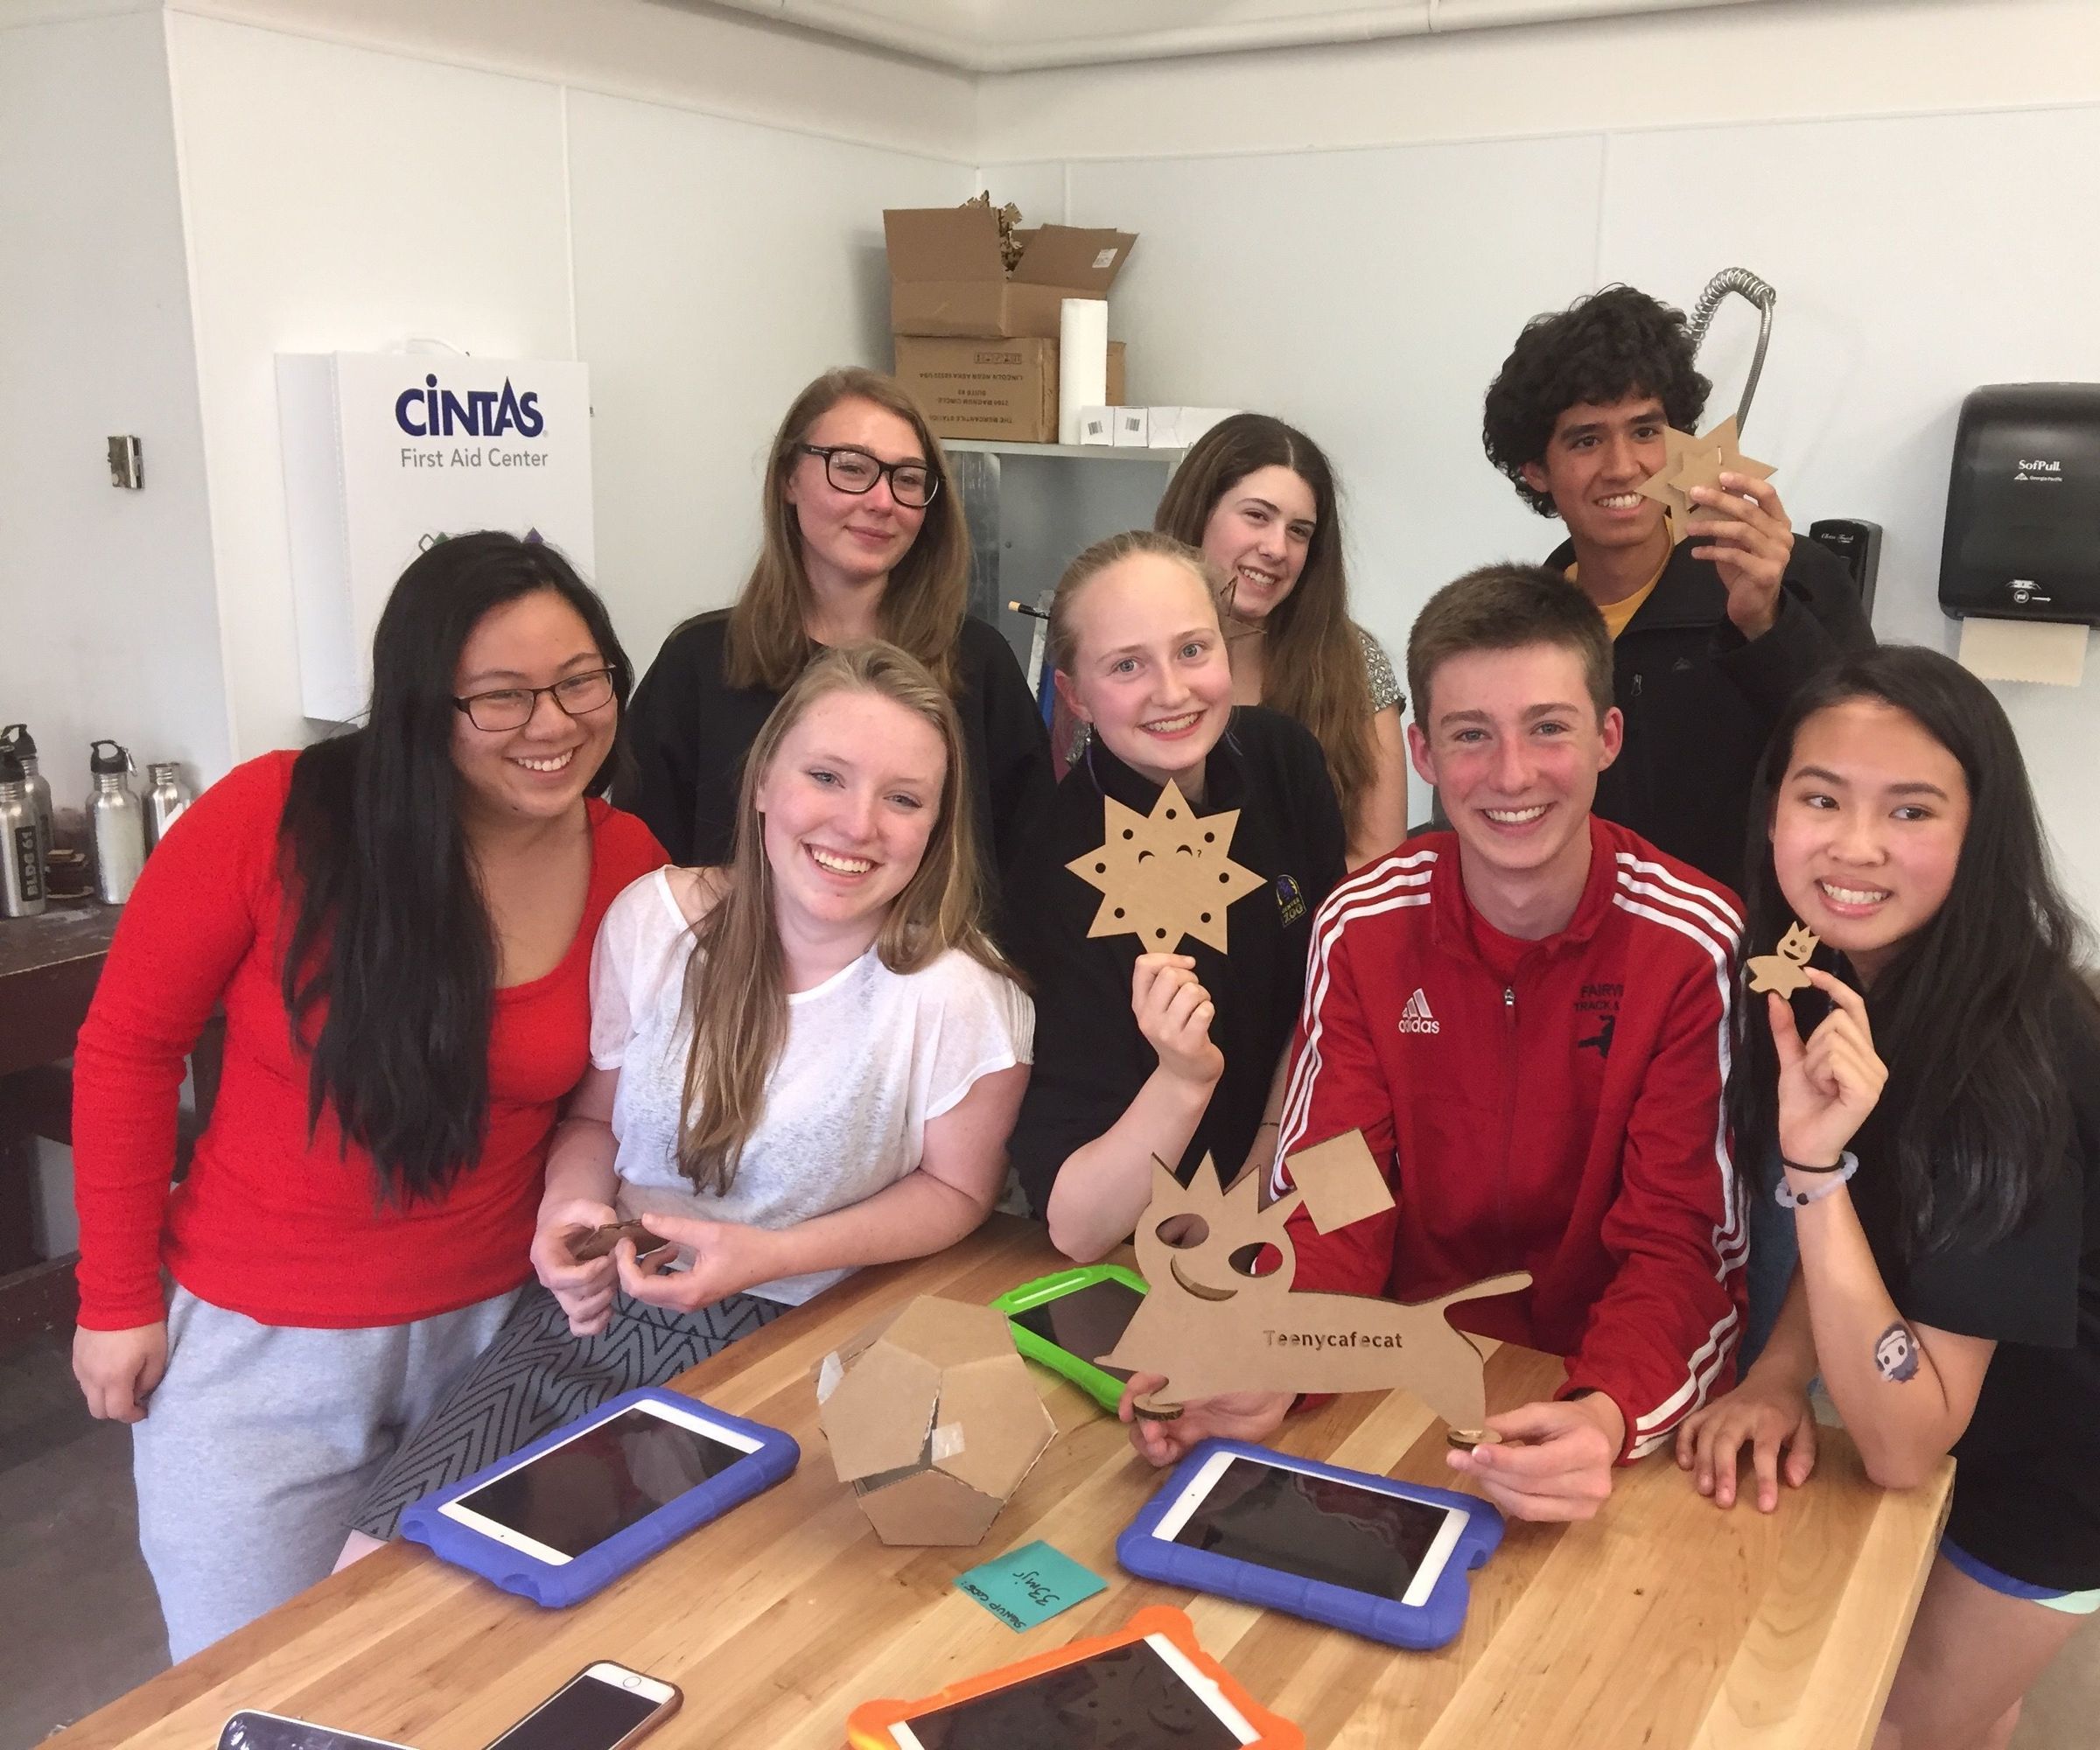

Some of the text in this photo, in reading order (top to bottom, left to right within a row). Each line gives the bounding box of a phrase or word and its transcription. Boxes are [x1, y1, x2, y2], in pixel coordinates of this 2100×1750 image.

[396, 374, 544, 438] CINTAS
[401, 447, 549, 467] First Aid Center
[2018, 459, 2062, 472] SofPull
[1283, 903, 1304, 924] ZOO
[1573, 1000, 1610, 1012] TRACK
